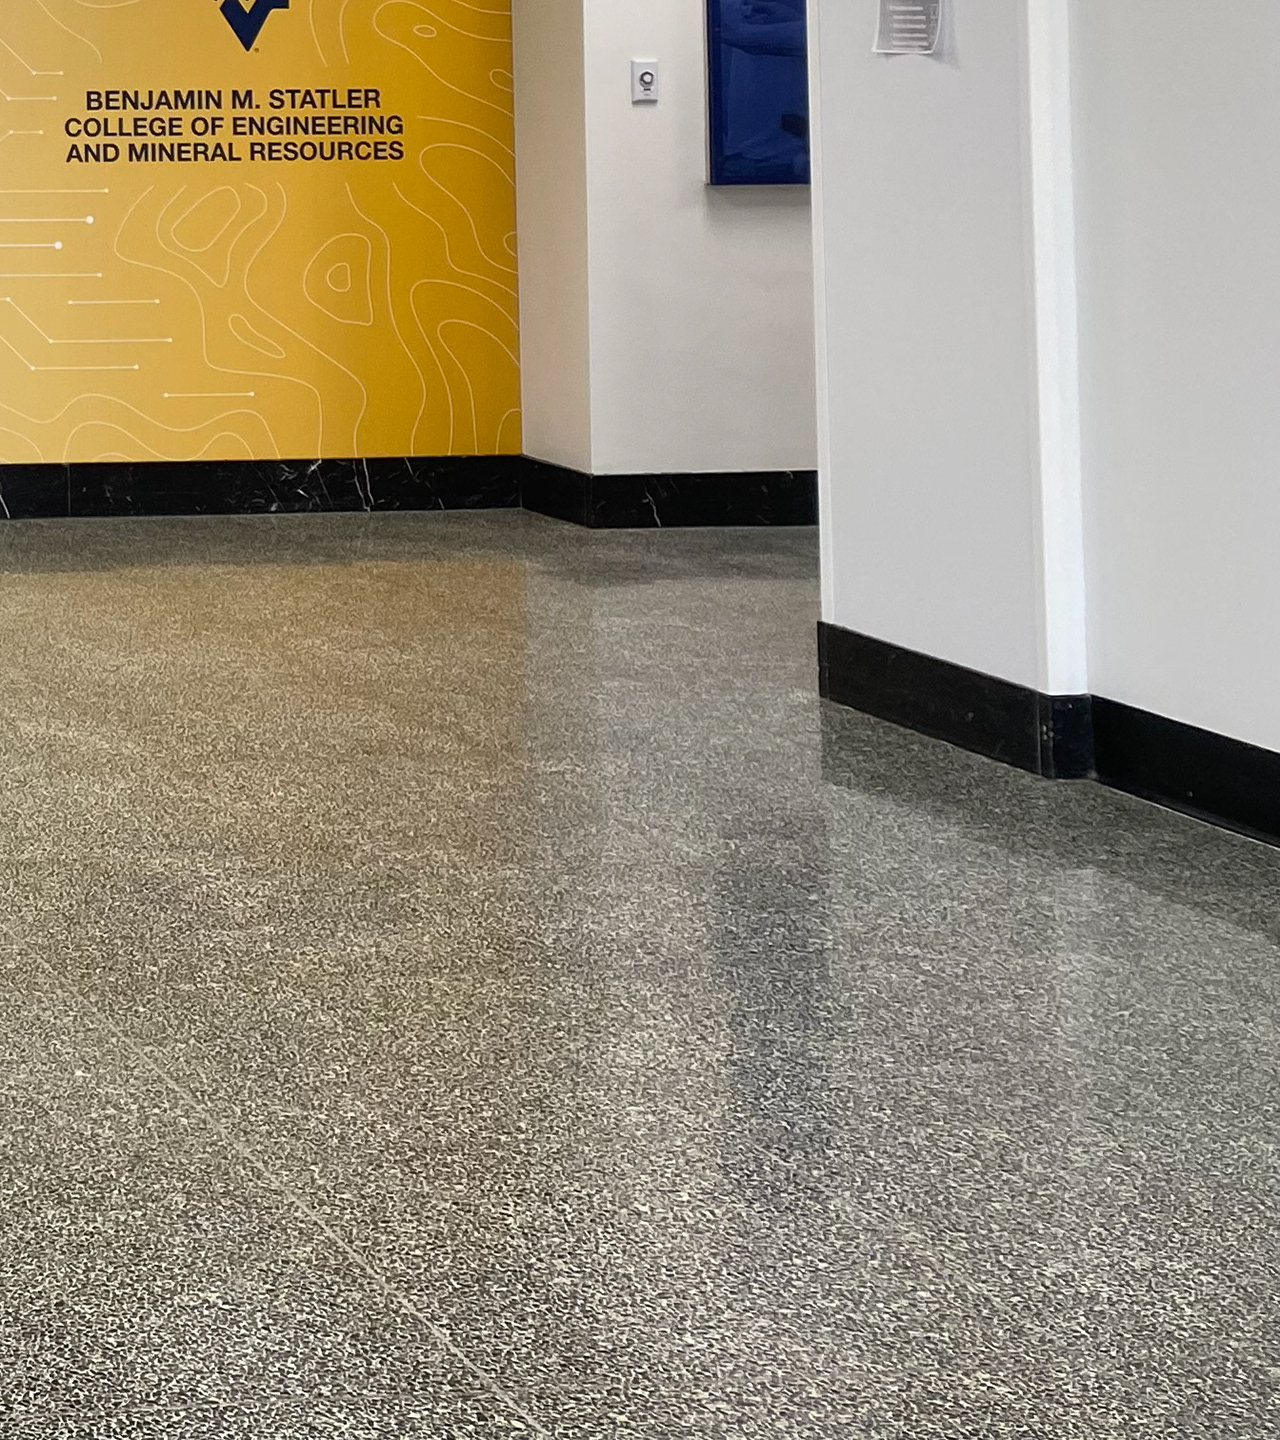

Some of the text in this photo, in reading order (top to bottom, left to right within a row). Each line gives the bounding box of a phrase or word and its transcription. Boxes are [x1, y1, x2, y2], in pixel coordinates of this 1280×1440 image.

[85, 88, 381, 111] BENJAMIN M. STATLER
[64, 115, 404, 137] COLLEGE OF ENGINEERING
[66, 141, 405, 163] AND MINERAL RESOURCES
